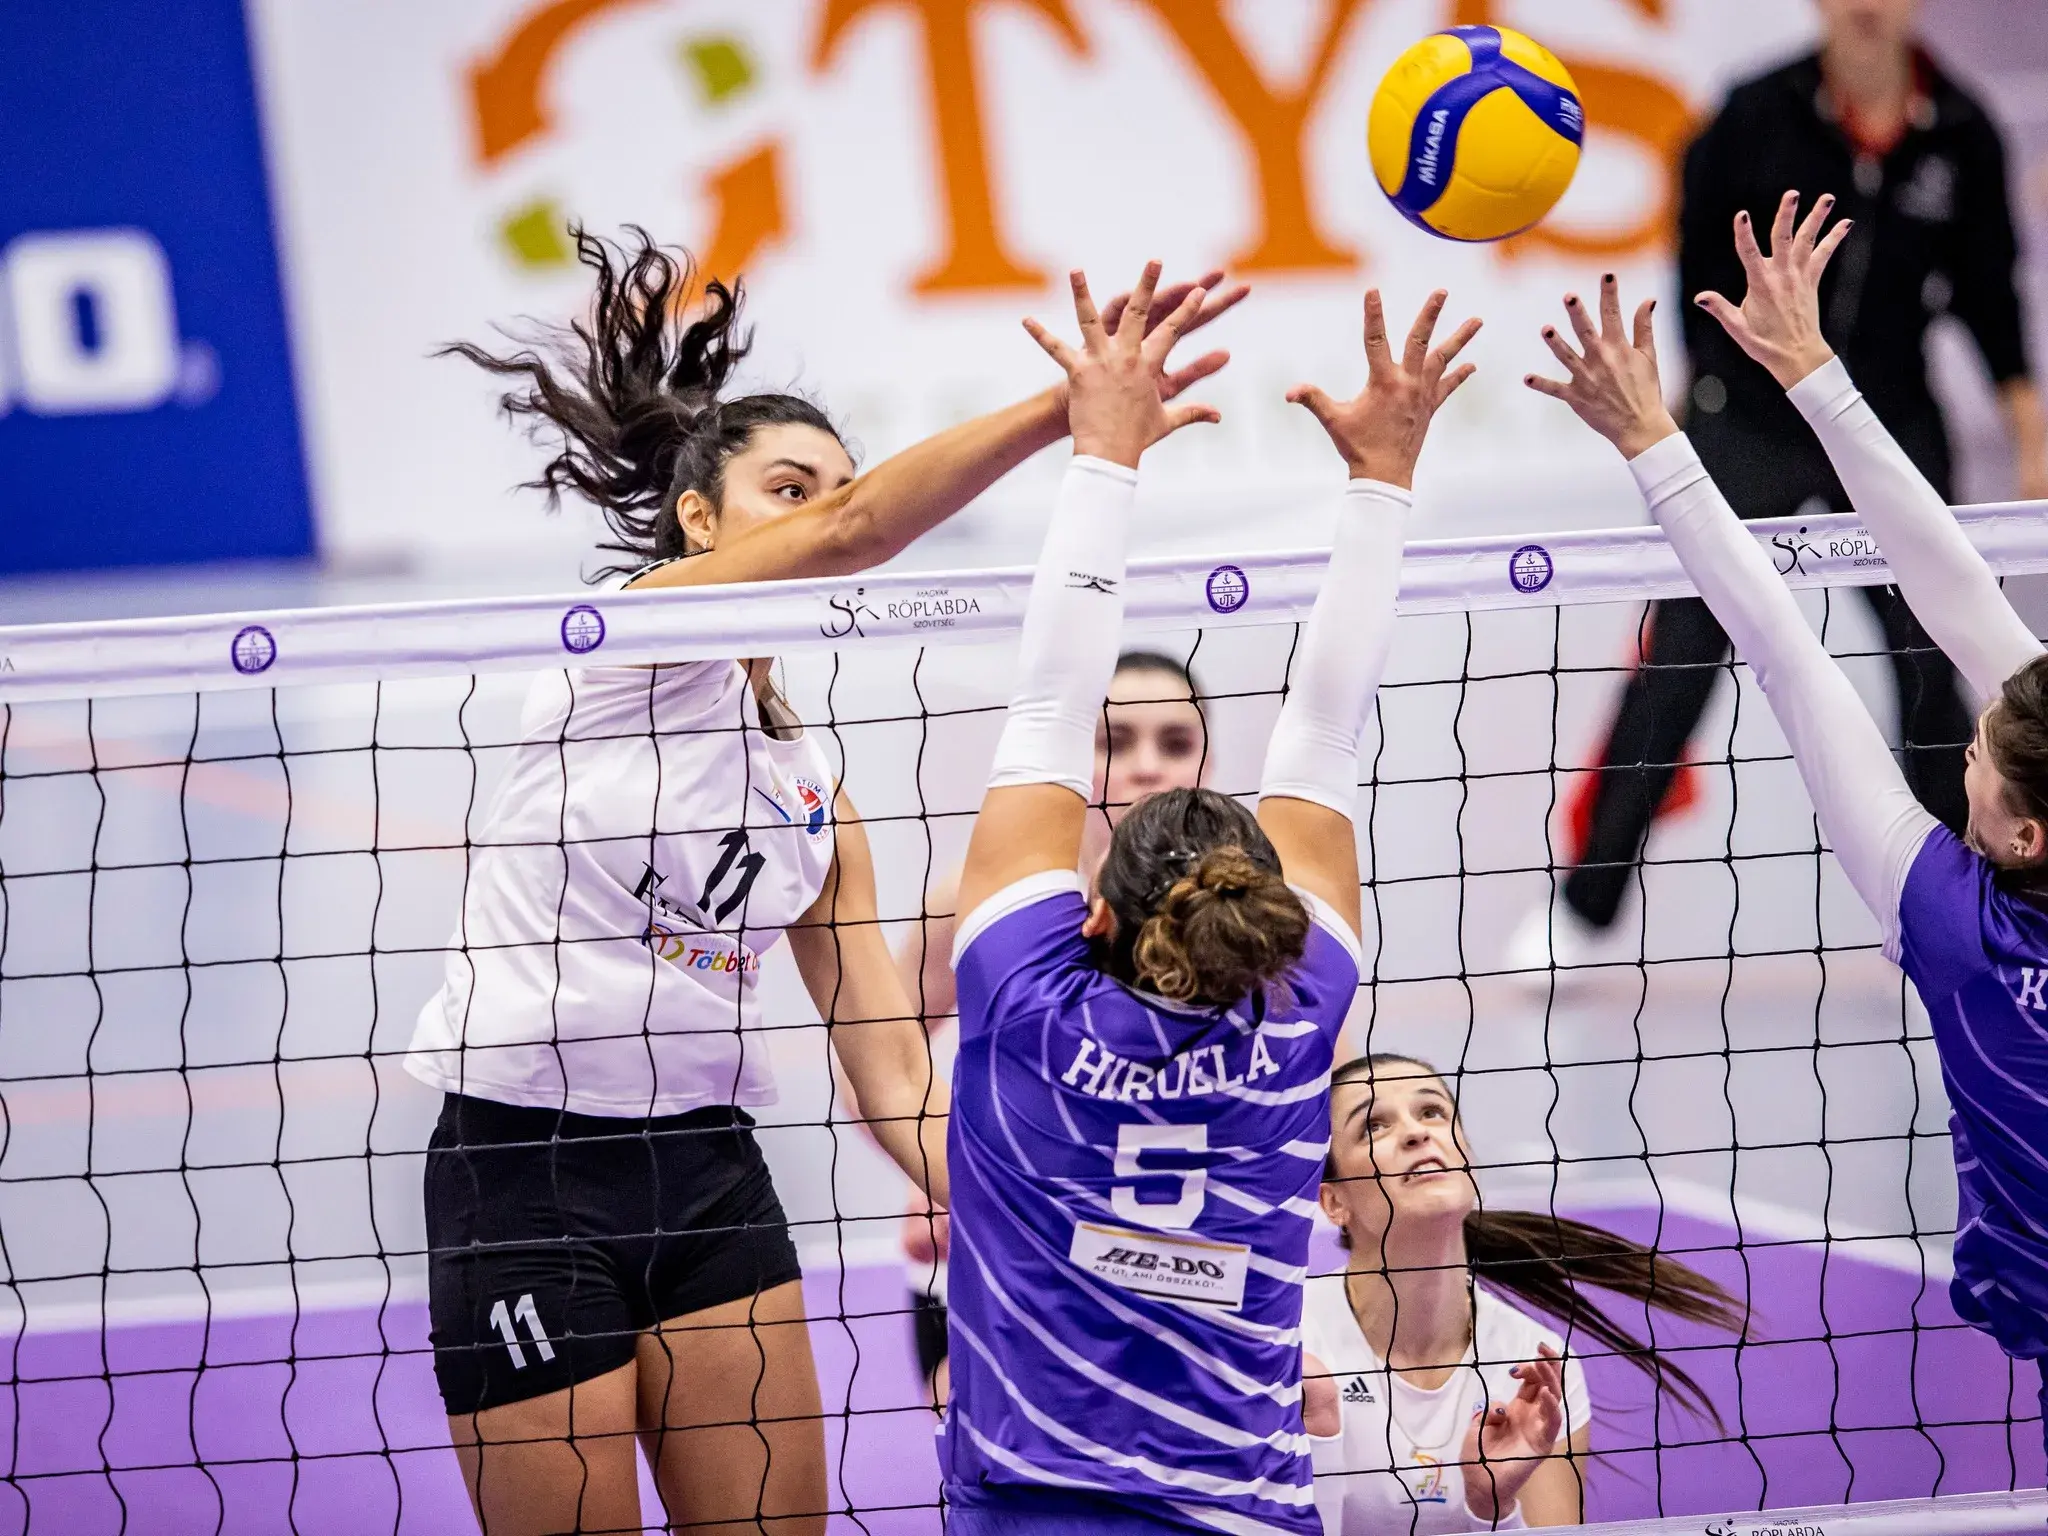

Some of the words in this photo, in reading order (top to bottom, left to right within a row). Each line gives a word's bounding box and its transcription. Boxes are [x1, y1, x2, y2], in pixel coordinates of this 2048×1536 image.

[1415, 109, 1450, 186] MIKASA
[888, 598, 981, 619] RÖPLABDA
[696, 830, 767, 926] 11
[1061, 1033, 1281, 1101] HIRUELA
[1110, 1123, 1208, 1229] 5
[1096, 1246, 1225, 1280] HE-DO
[1132, 1272, 1153, 1280] AMI
[489, 1293, 556, 1370] 11
